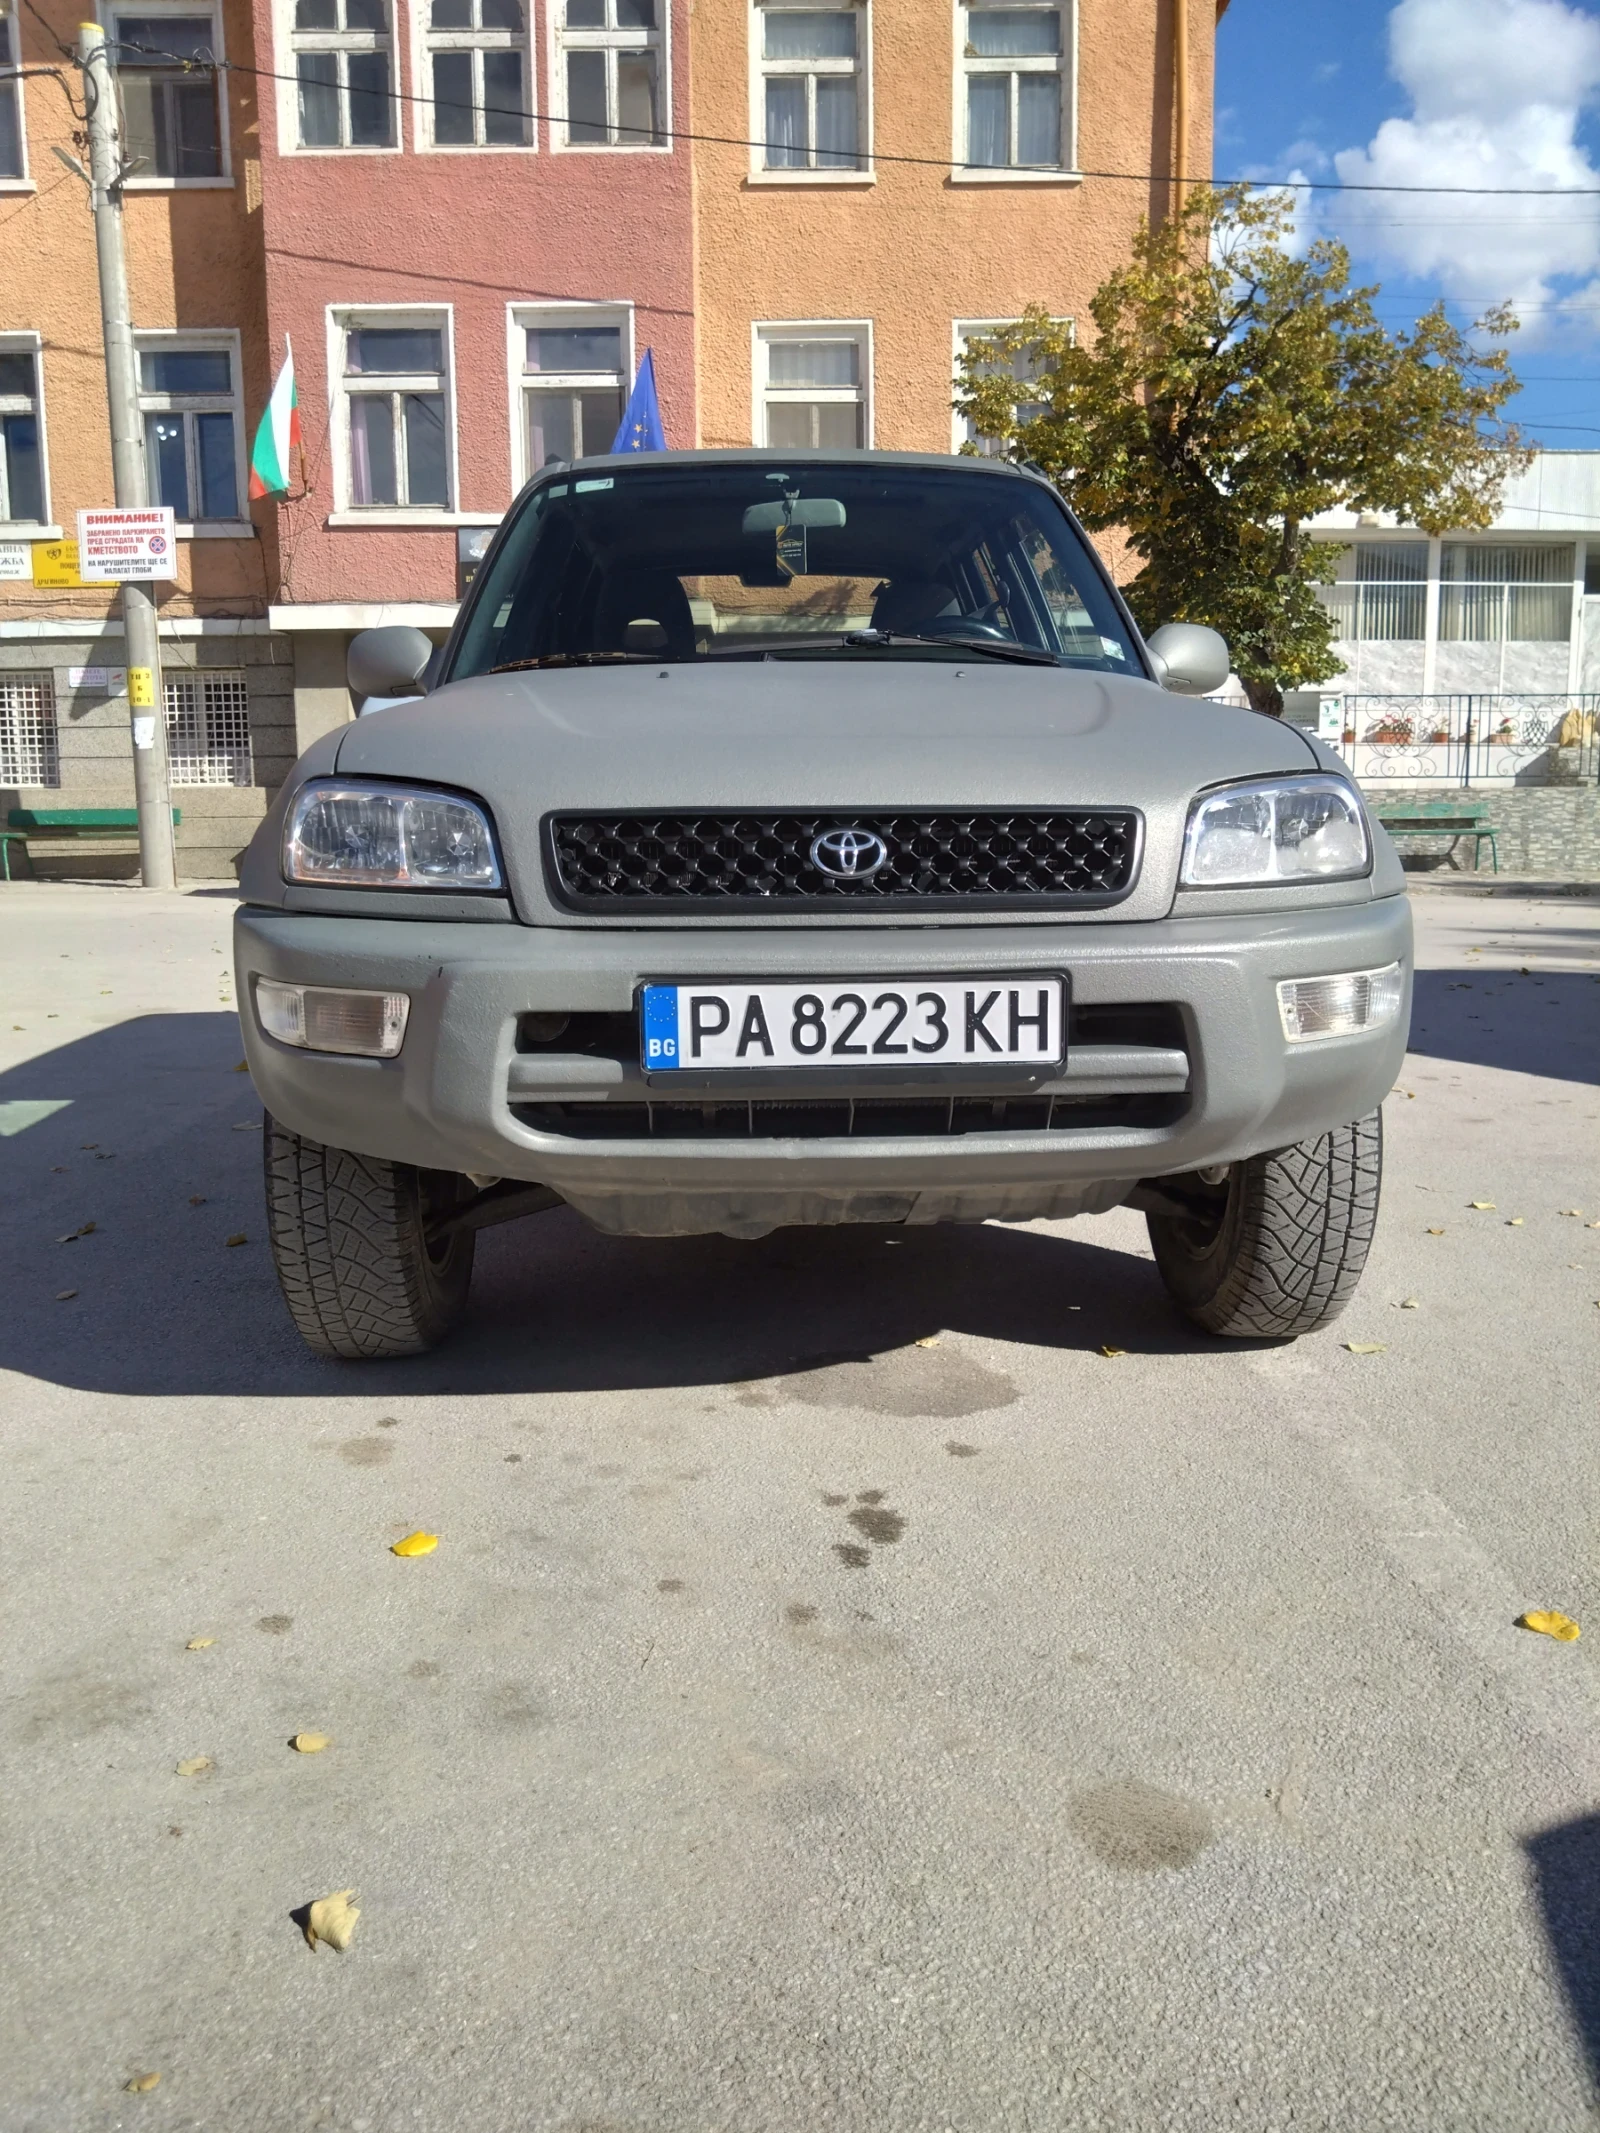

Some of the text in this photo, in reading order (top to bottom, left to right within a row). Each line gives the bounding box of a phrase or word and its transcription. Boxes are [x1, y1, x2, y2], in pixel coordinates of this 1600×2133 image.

[86, 513, 164, 525] ВНИМАНИЕ!
[86, 529, 121, 537] ЗАБРАНЕНО
[104, 537, 134, 545] СГРАДАТА
[88, 546, 138, 556] КМЕТСТВОТО
[0, 557, 25, 566] ЖБА
[97, 558, 146, 566] НАРУШИТЕЛИТЕ
[147, 558, 158, 566] ЩЕ
[690, 989, 1049, 1058] PA 8223 KH
[648, 1039, 676, 1058] BG
